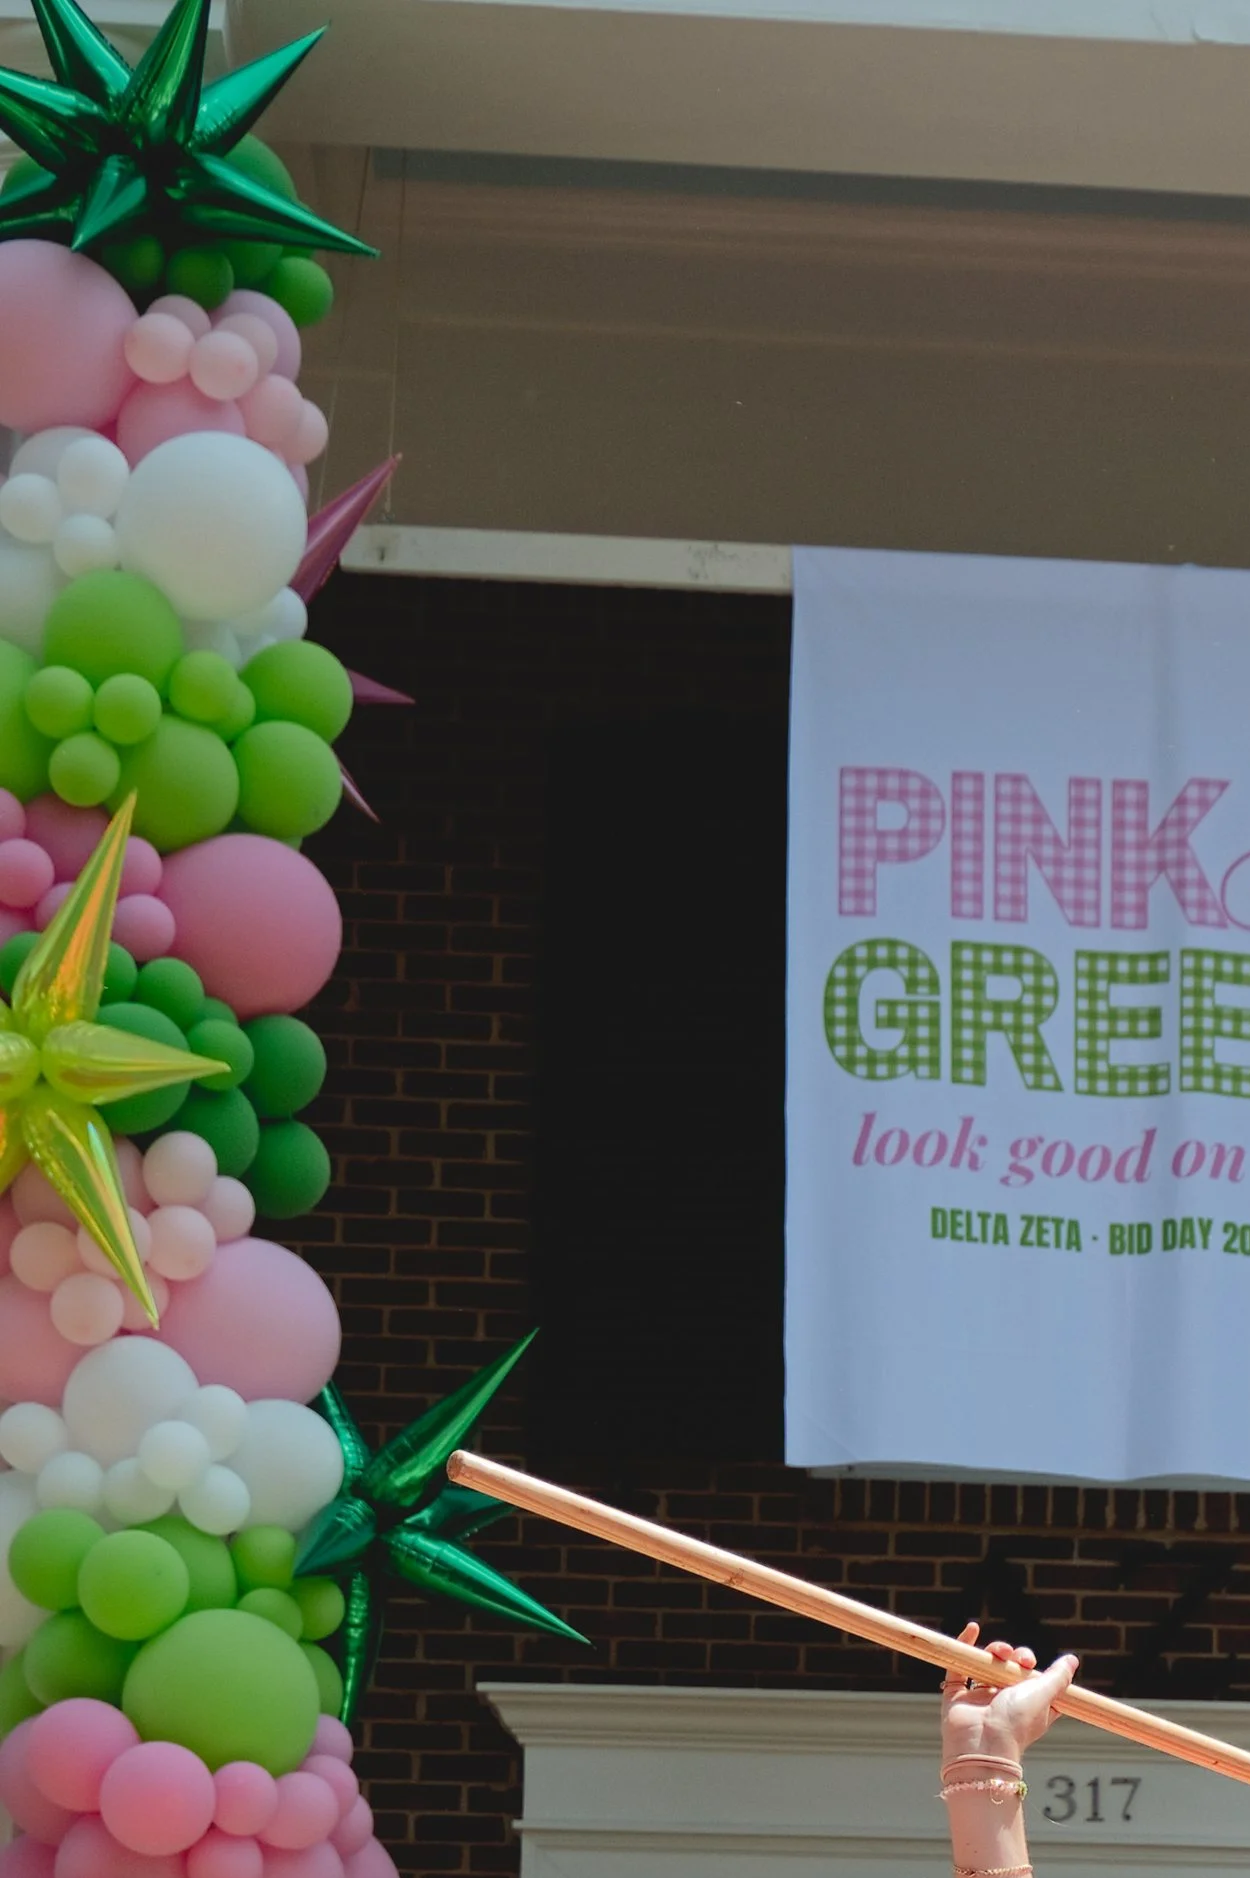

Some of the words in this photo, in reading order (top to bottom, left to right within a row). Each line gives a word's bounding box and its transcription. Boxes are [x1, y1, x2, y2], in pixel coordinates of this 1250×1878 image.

[851, 1111, 989, 1173] look
[1000, 1126, 1160, 1187] good
[1170, 1138, 1246, 1184] on
[930, 1206, 1009, 1246] DELTA
[1020, 1213, 1083, 1252] ZETA
[1108, 1222, 1153, 1256] BID
[1161, 1216, 1214, 1252] DAY
[1042, 1775, 1142, 1824] 317
